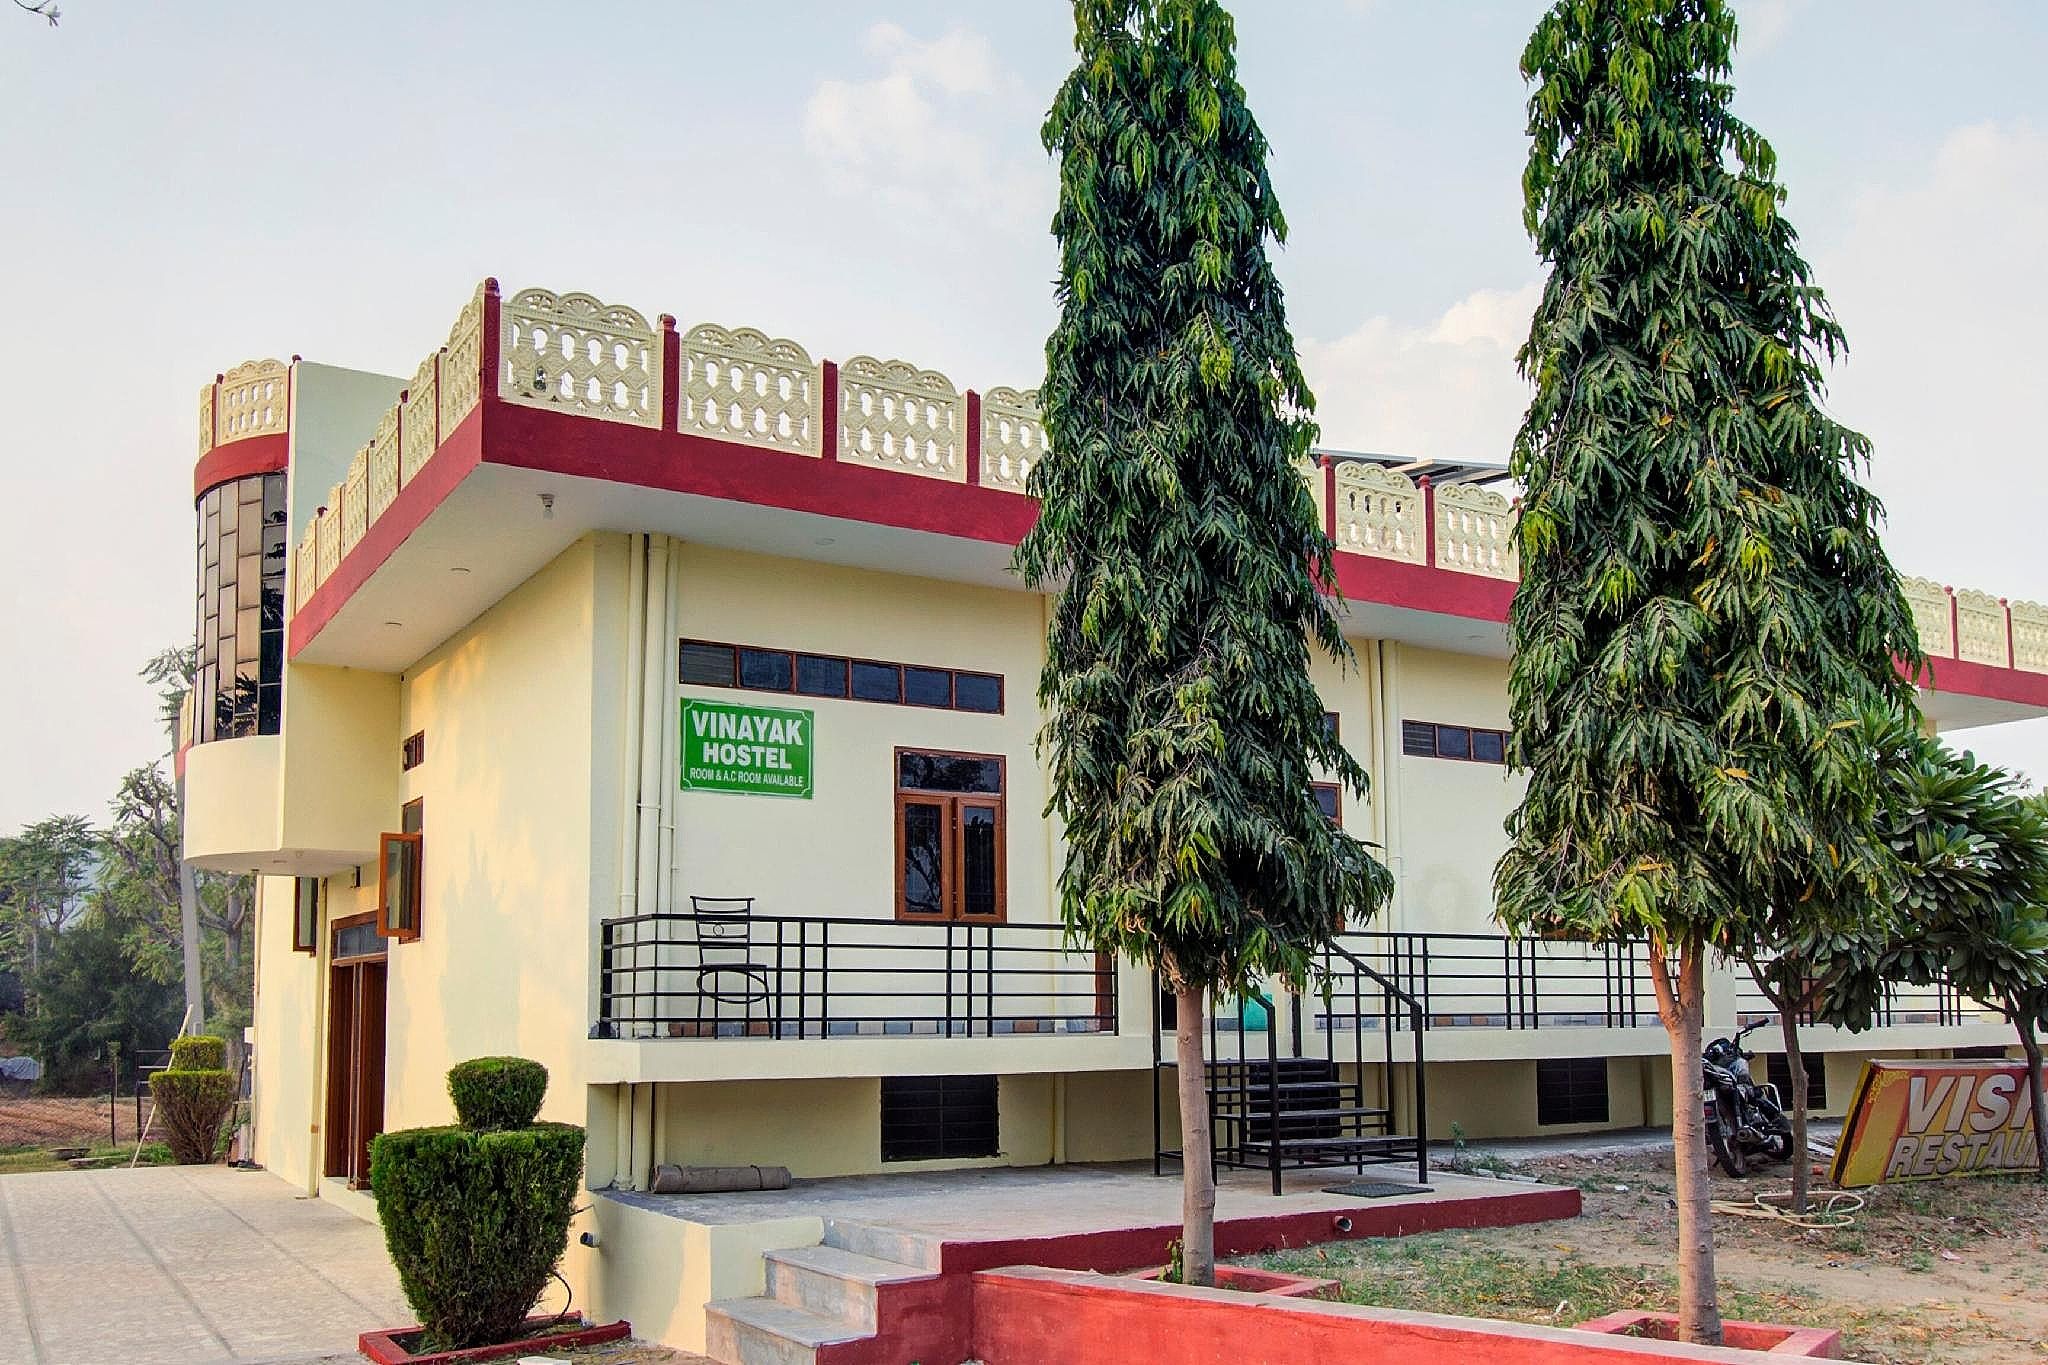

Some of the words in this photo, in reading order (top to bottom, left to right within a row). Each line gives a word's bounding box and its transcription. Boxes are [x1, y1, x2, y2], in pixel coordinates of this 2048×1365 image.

[691, 710, 804, 745] VINAYAK
[703, 741, 792, 769] HOSTEL
[690, 768, 714, 780] ROOM
[715, 770, 722, 781] &
[723, 770, 737, 783] A.C
[738, 771, 761, 784] ROOM
[763, 773, 804, 787] AVAILABLE
